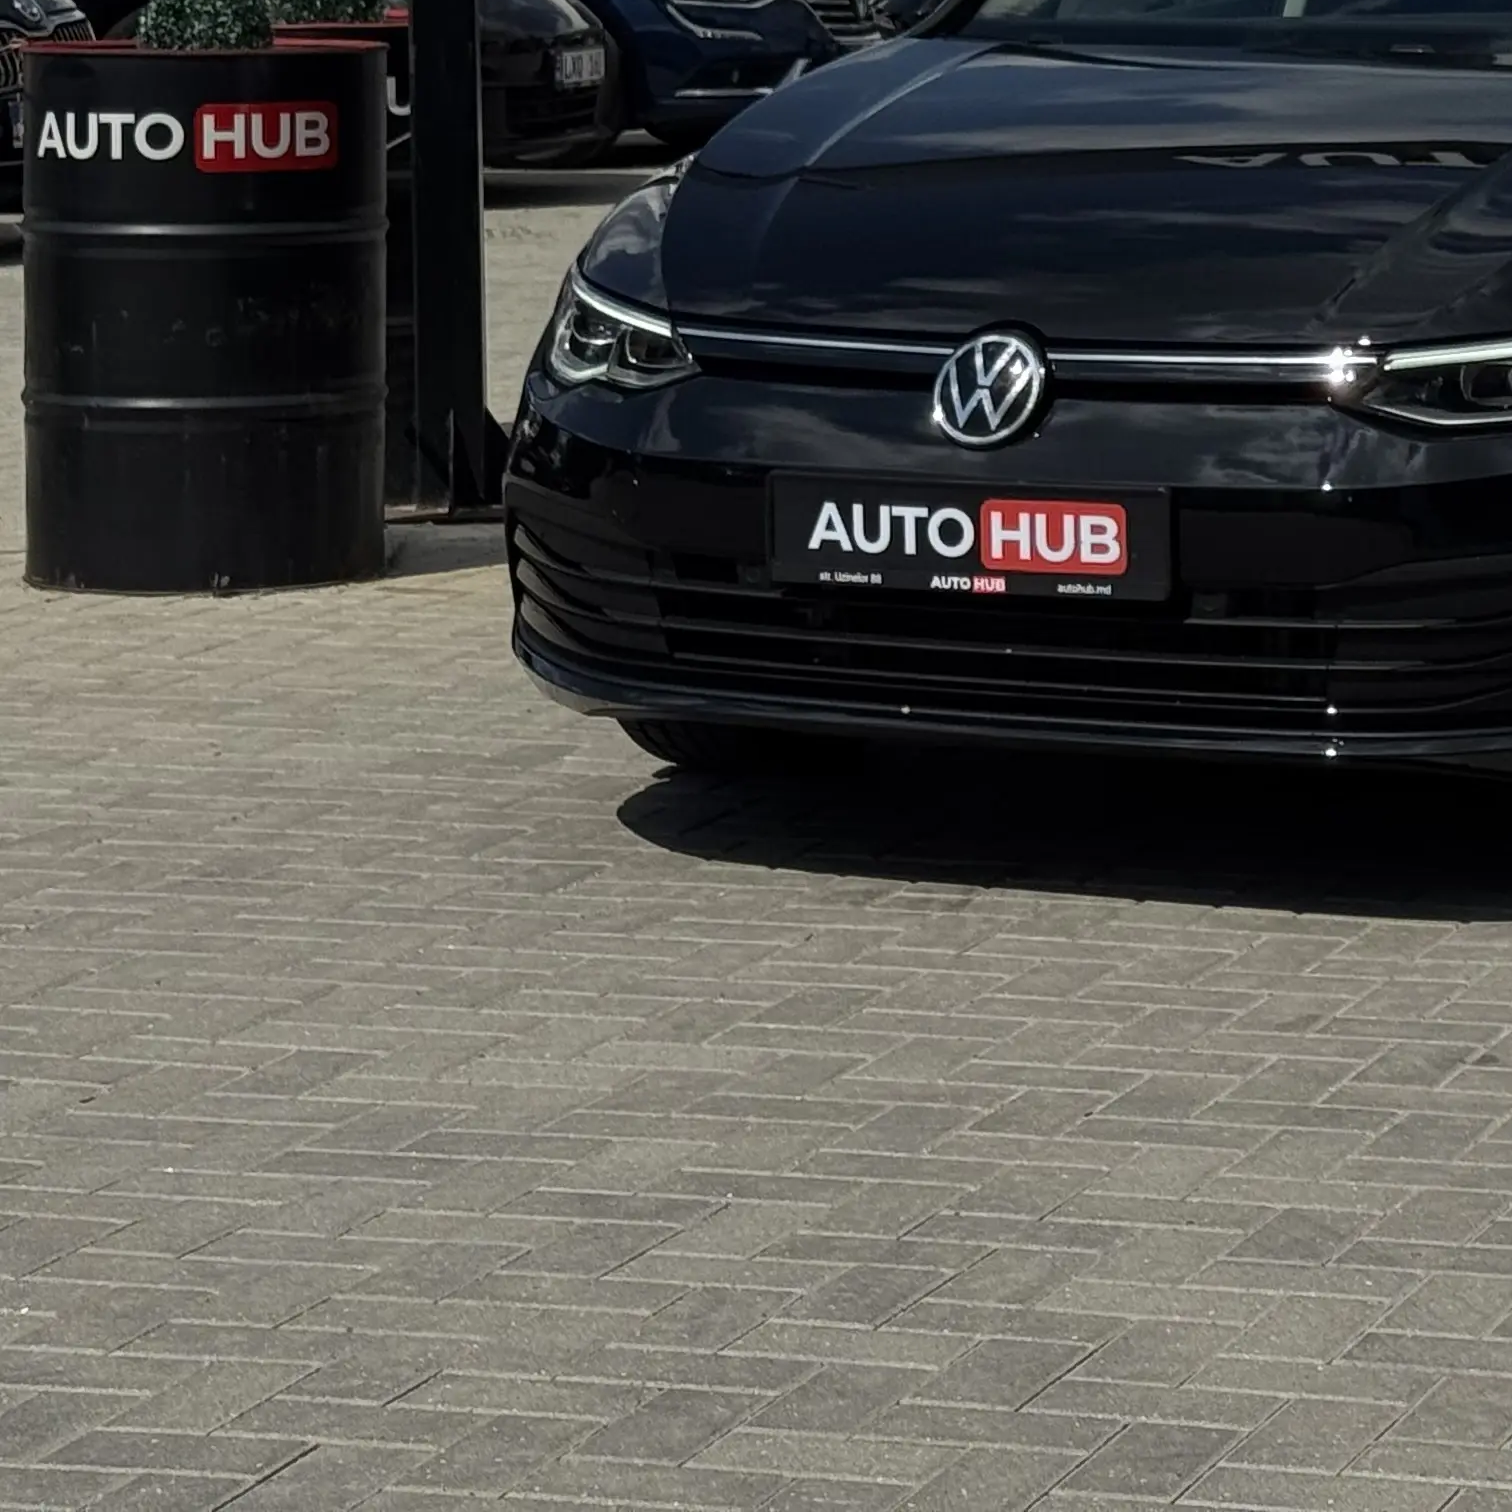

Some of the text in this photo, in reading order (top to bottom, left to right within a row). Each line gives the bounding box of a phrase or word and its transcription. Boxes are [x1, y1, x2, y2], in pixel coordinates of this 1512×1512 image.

[37, 111, 185, 161] AUTO
[202, 113, 331, 158] HUB
[808, 501, 1121, 564] AUTO HUB
[930, 575, 1006, 593] AUTO HUB
